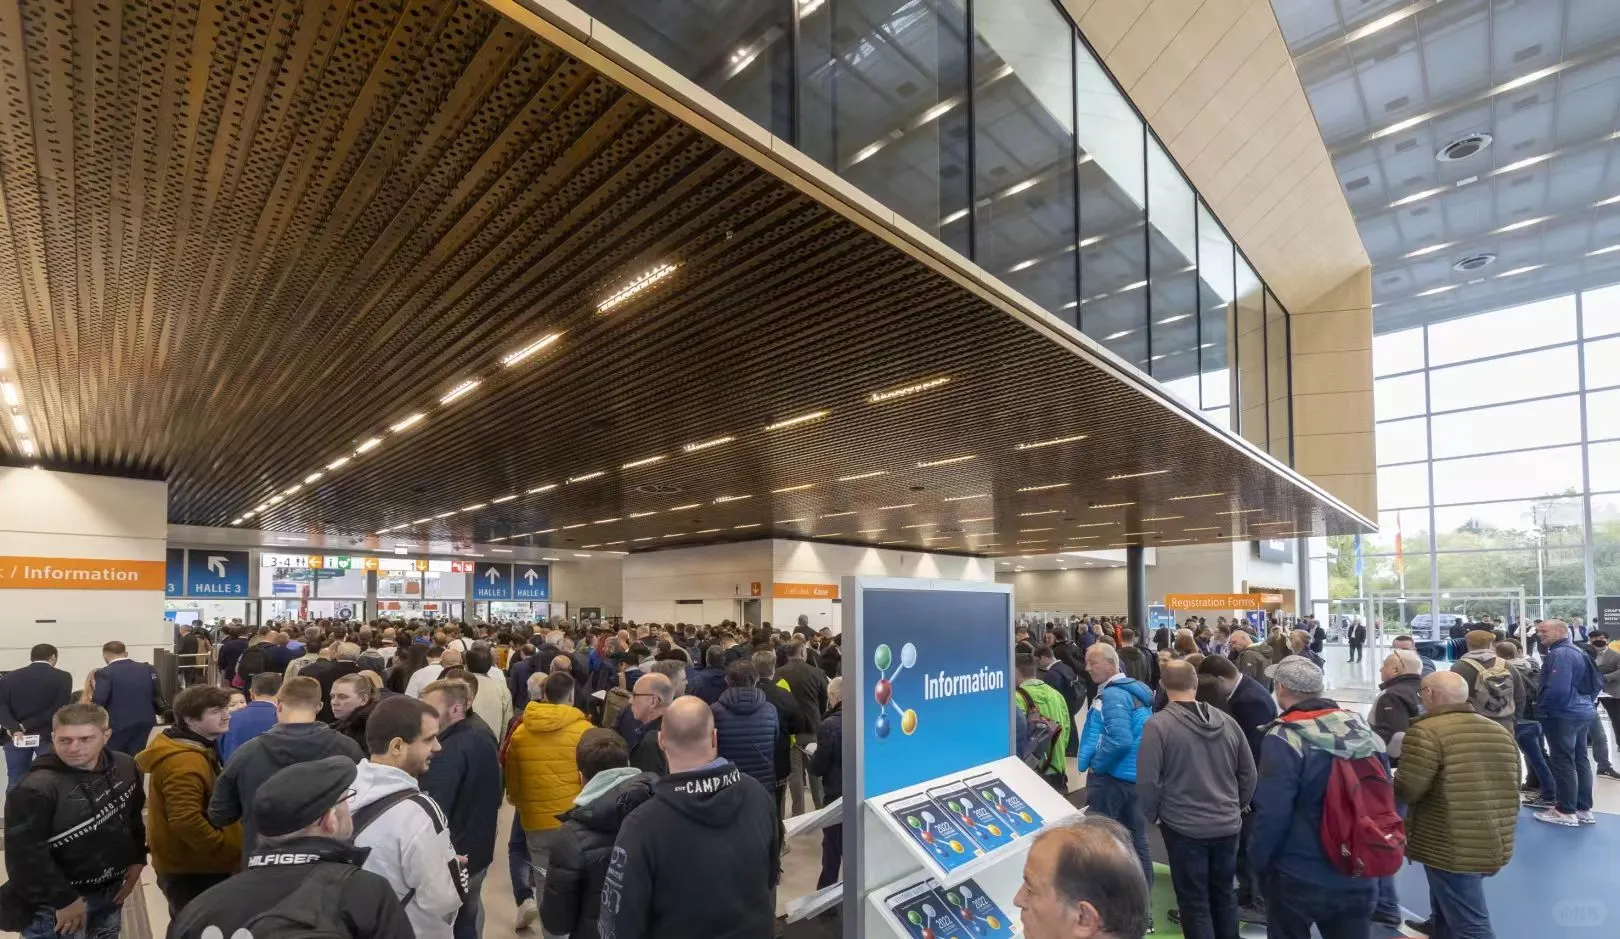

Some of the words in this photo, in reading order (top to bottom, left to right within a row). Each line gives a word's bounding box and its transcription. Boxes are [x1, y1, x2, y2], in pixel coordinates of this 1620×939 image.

[24, 565, 139, 581] Information
[195, 583, 232, 594] HALLE
[234, 584, 242, 594] 3
[478, 588, 501, 597] HALLE
[517, 589, 539, 598] HALLE
[539, 590, 545, 598] 4
[1171, 597, 1225, 610] Registration
[1228, 597, 1256, 608] Forms
[924, 666, 1003, 700] Information
[686, 777, 721, 794] CAMP
[971, 895, 989, 909] 2022
[935, 914, 953, 929] 2022
